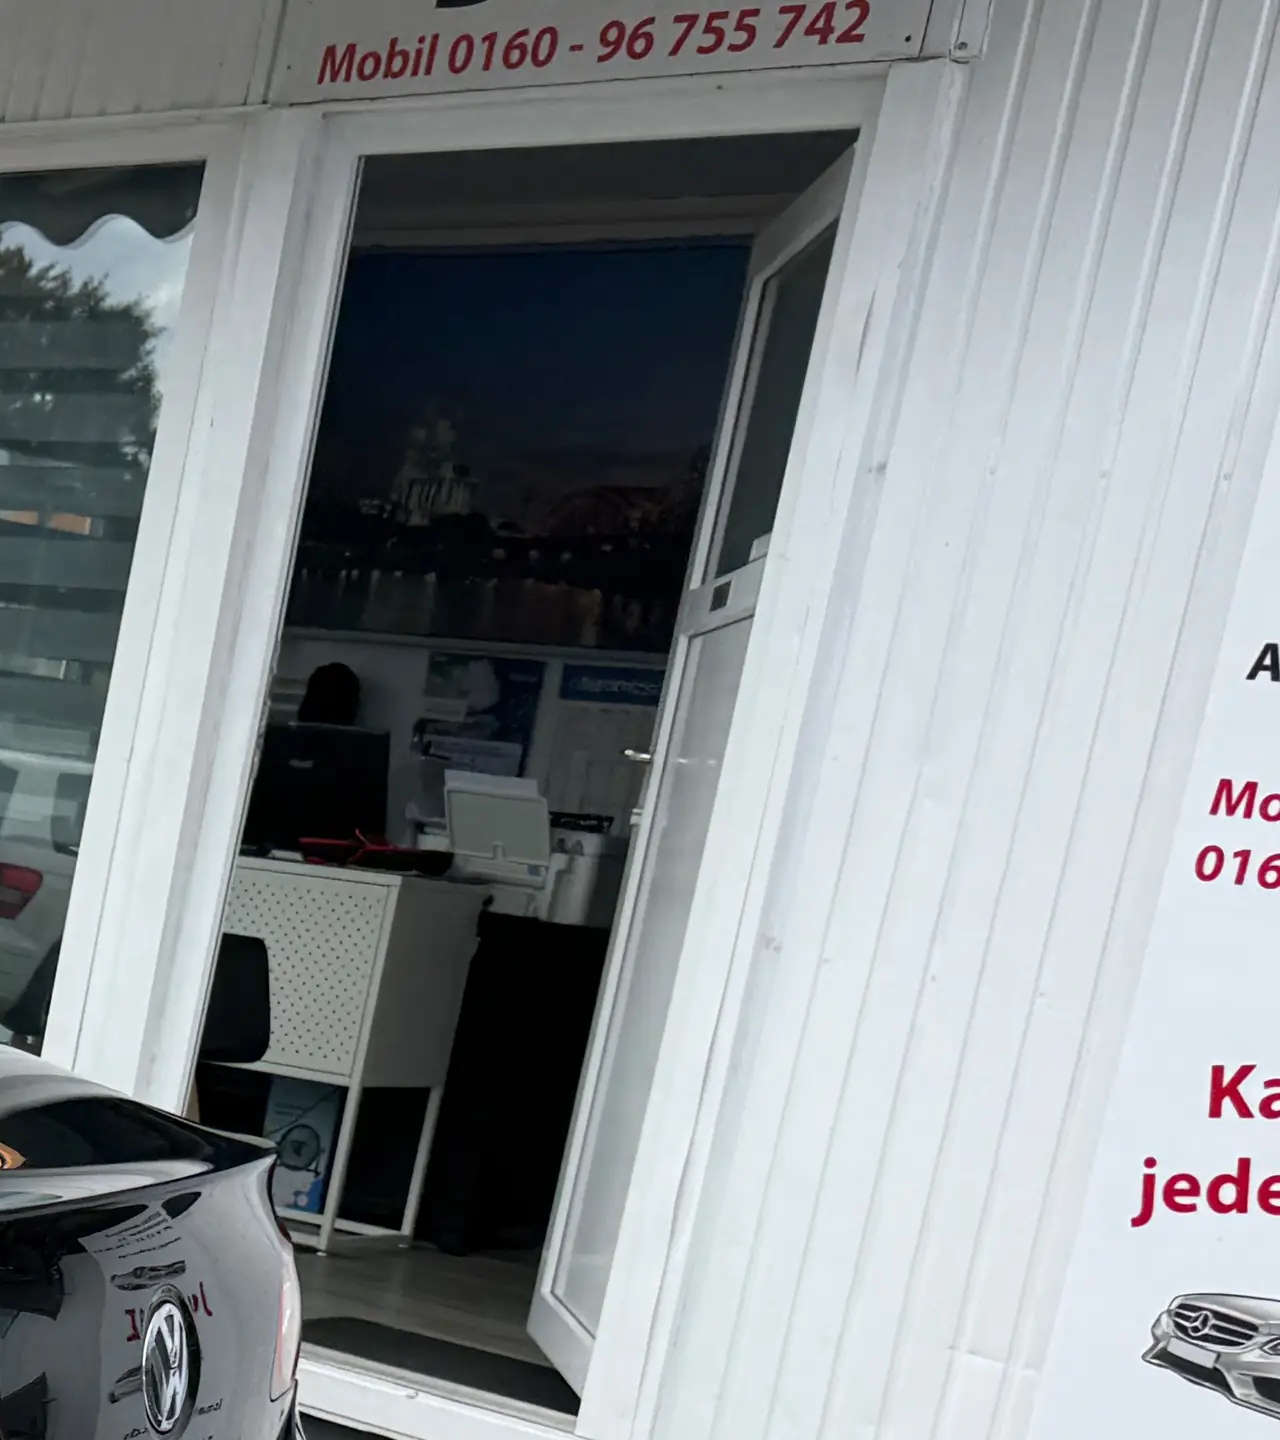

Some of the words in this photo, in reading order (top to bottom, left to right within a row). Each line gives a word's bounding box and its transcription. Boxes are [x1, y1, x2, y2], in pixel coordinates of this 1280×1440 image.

[317, 33, 440, 85] Mobil
[447, 26, 559, 75] 0160
[597, 16, 656, 63] 96
[667, 8, 761, 57] 755
[772, 0, 870, 49] 742
[1195, 845, 1280, 890] 016
[1208, 1064, 1280, 1120] Ka
[1131, 1156, 1280, 1228] jede
